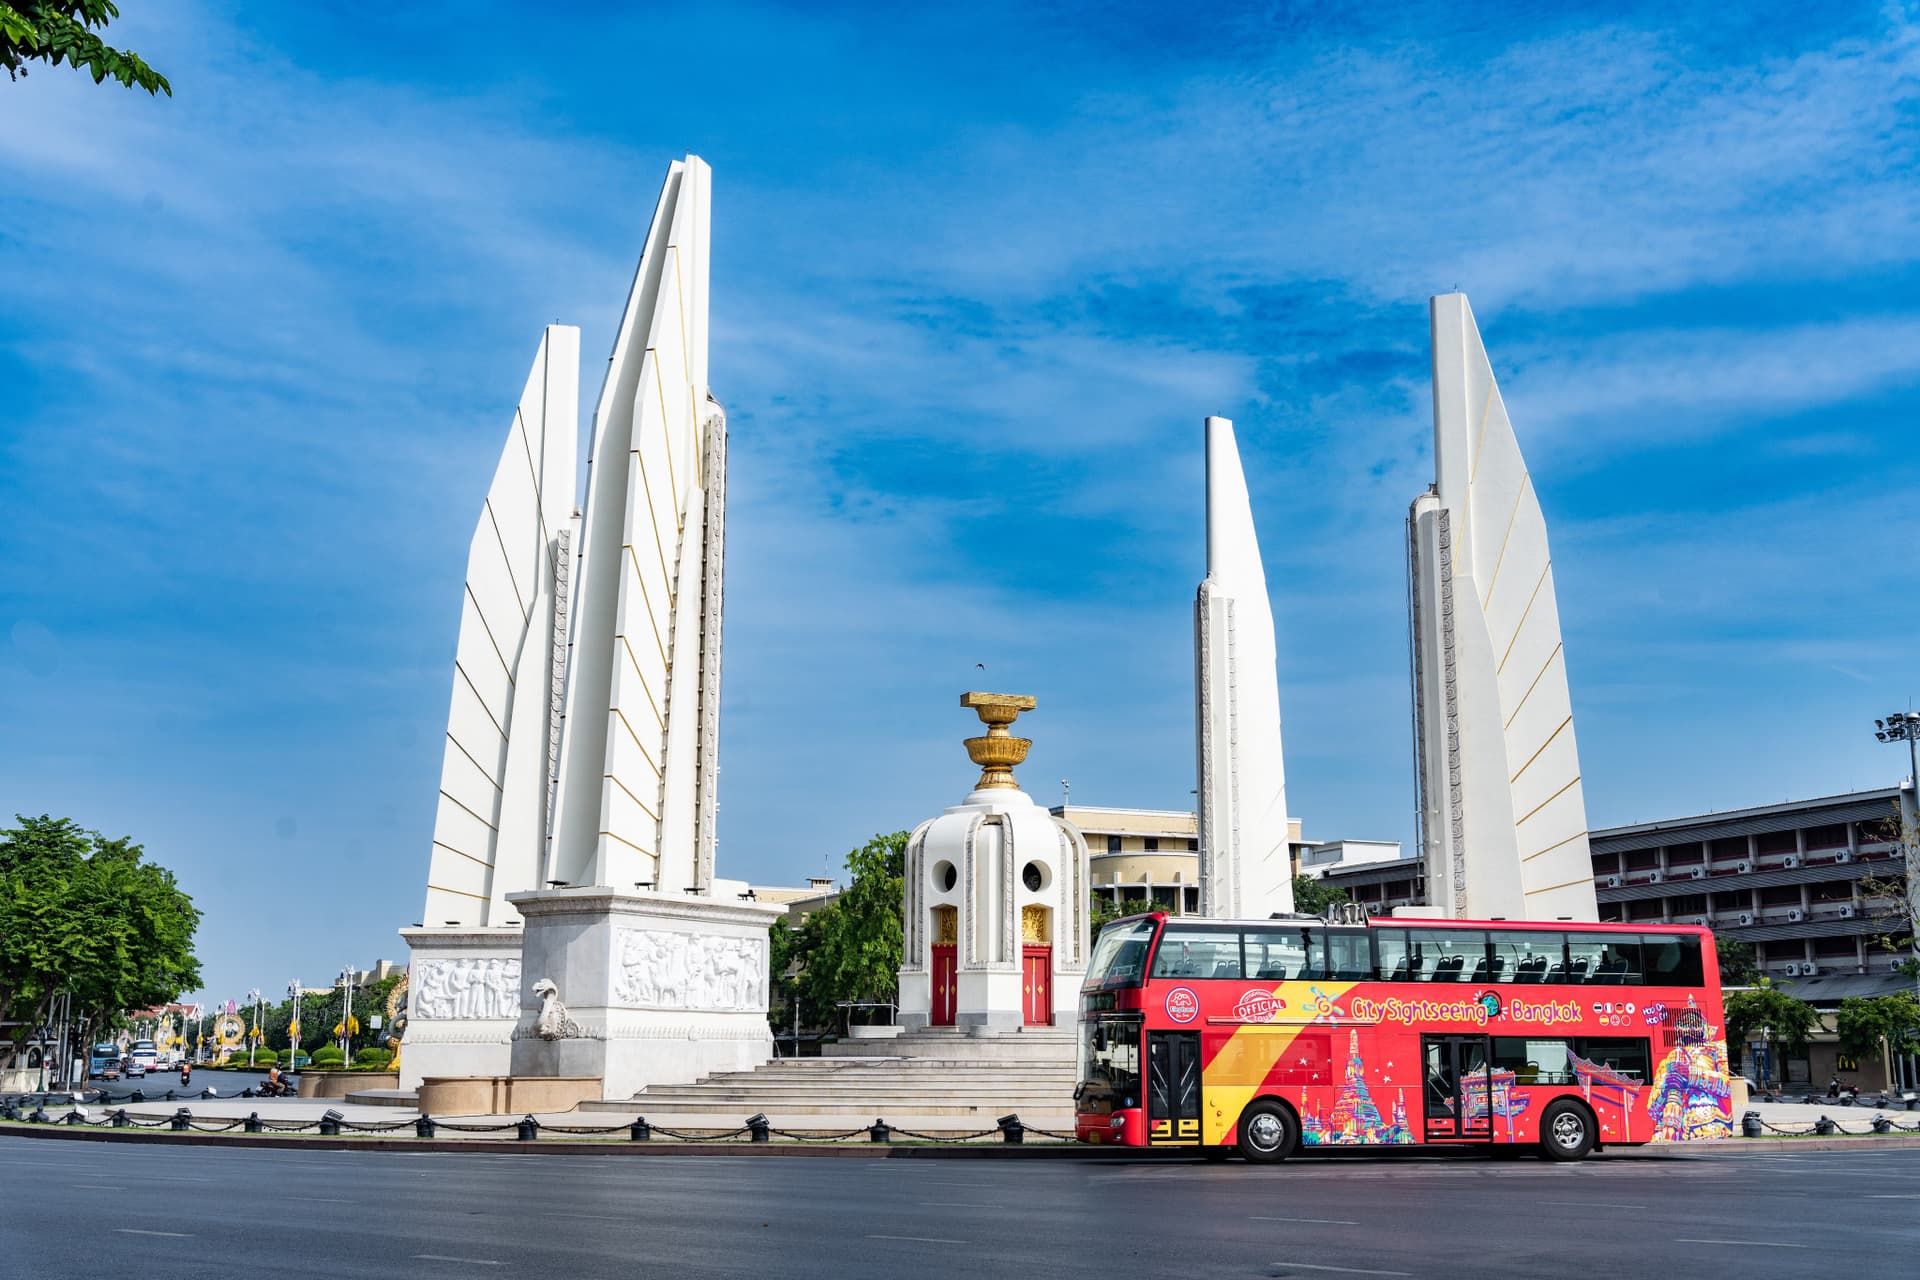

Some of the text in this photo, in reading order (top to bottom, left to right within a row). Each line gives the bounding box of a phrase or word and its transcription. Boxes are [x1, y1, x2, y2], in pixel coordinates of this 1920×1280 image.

[1238, 1000, 1285, 1018] OFFICIAL
[1387, 998, 1487, 1025] Sightseeing
[1511, 999, 1582, 1025] Bangkok
